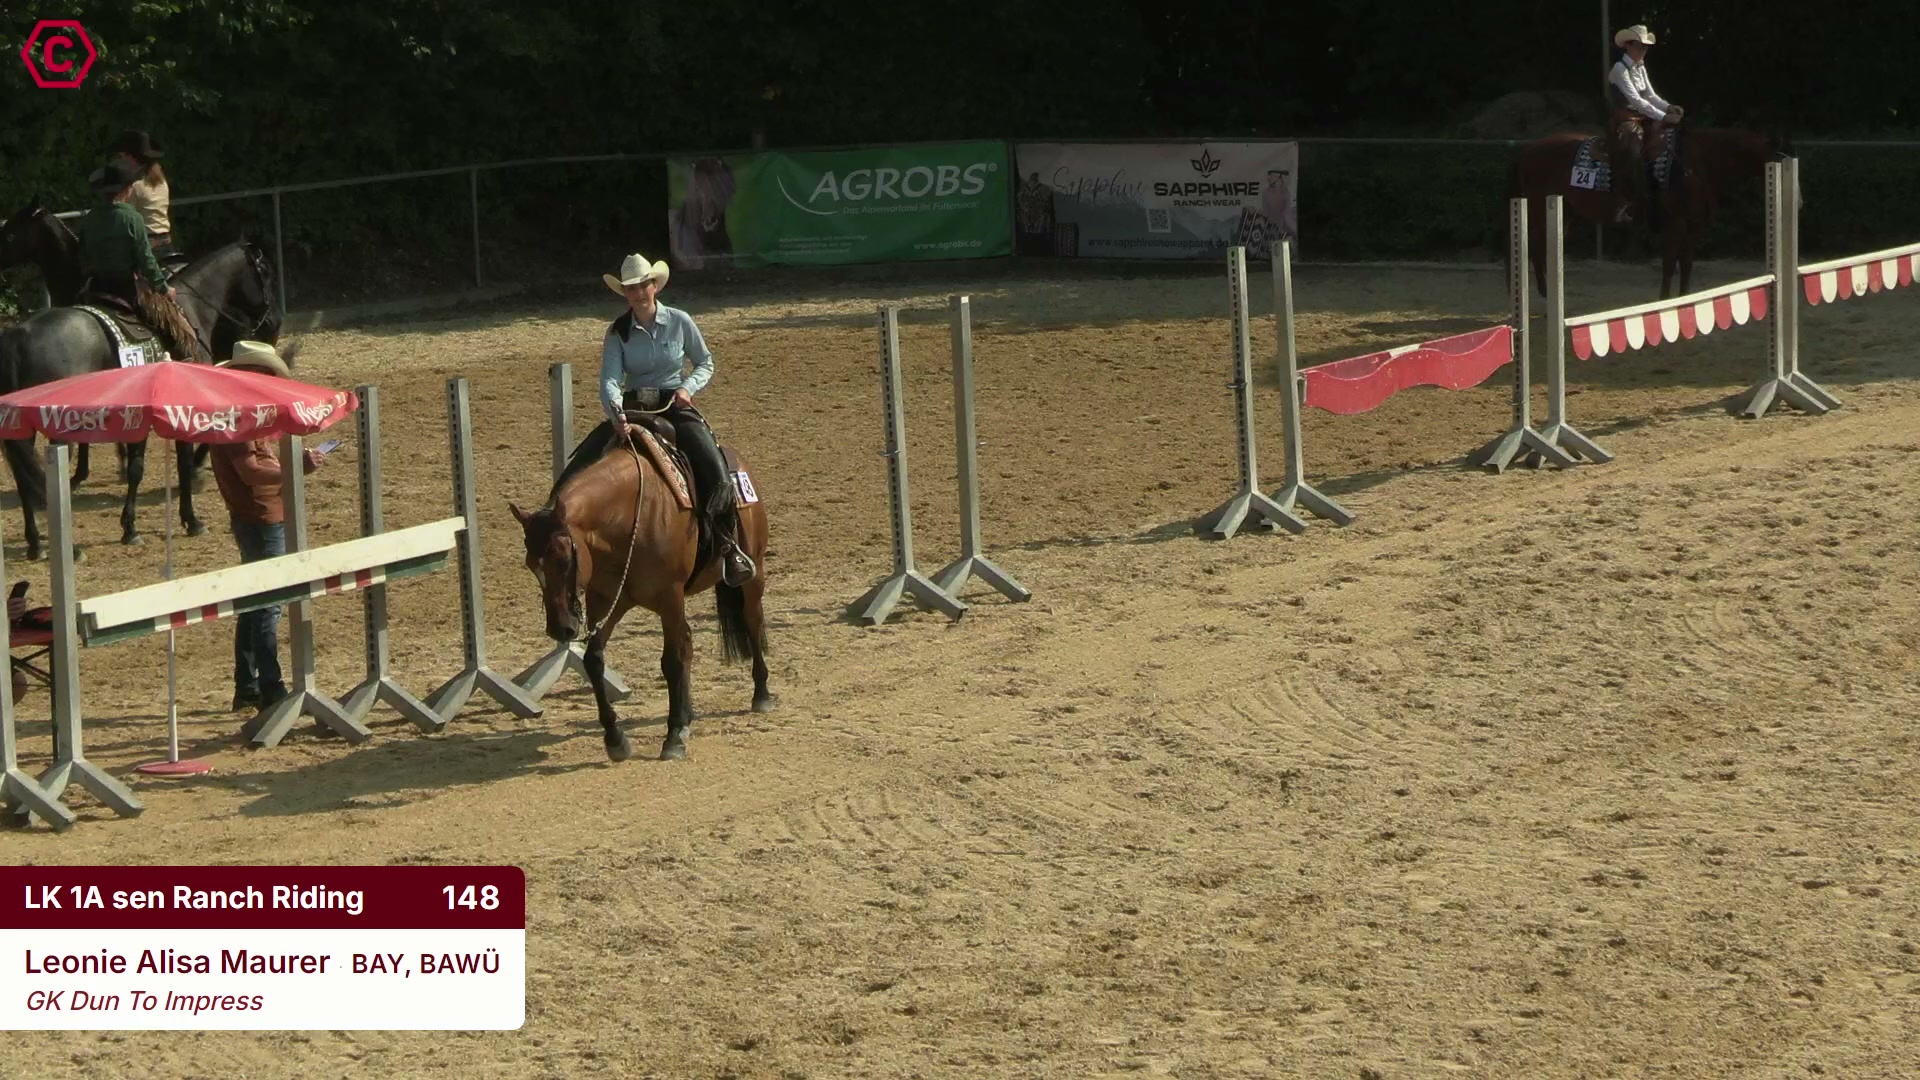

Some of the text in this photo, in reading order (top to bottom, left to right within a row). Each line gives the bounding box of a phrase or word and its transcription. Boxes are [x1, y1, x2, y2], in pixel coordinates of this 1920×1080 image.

[1576, 171, 1590, 184] 24
[1154, 181, 1260, 196] SAPPHIRE
[1174, 199, 1241, 207] RANCH WEAR
[40, 405, 109, 432] West
[163, 404, 241, 432] West
